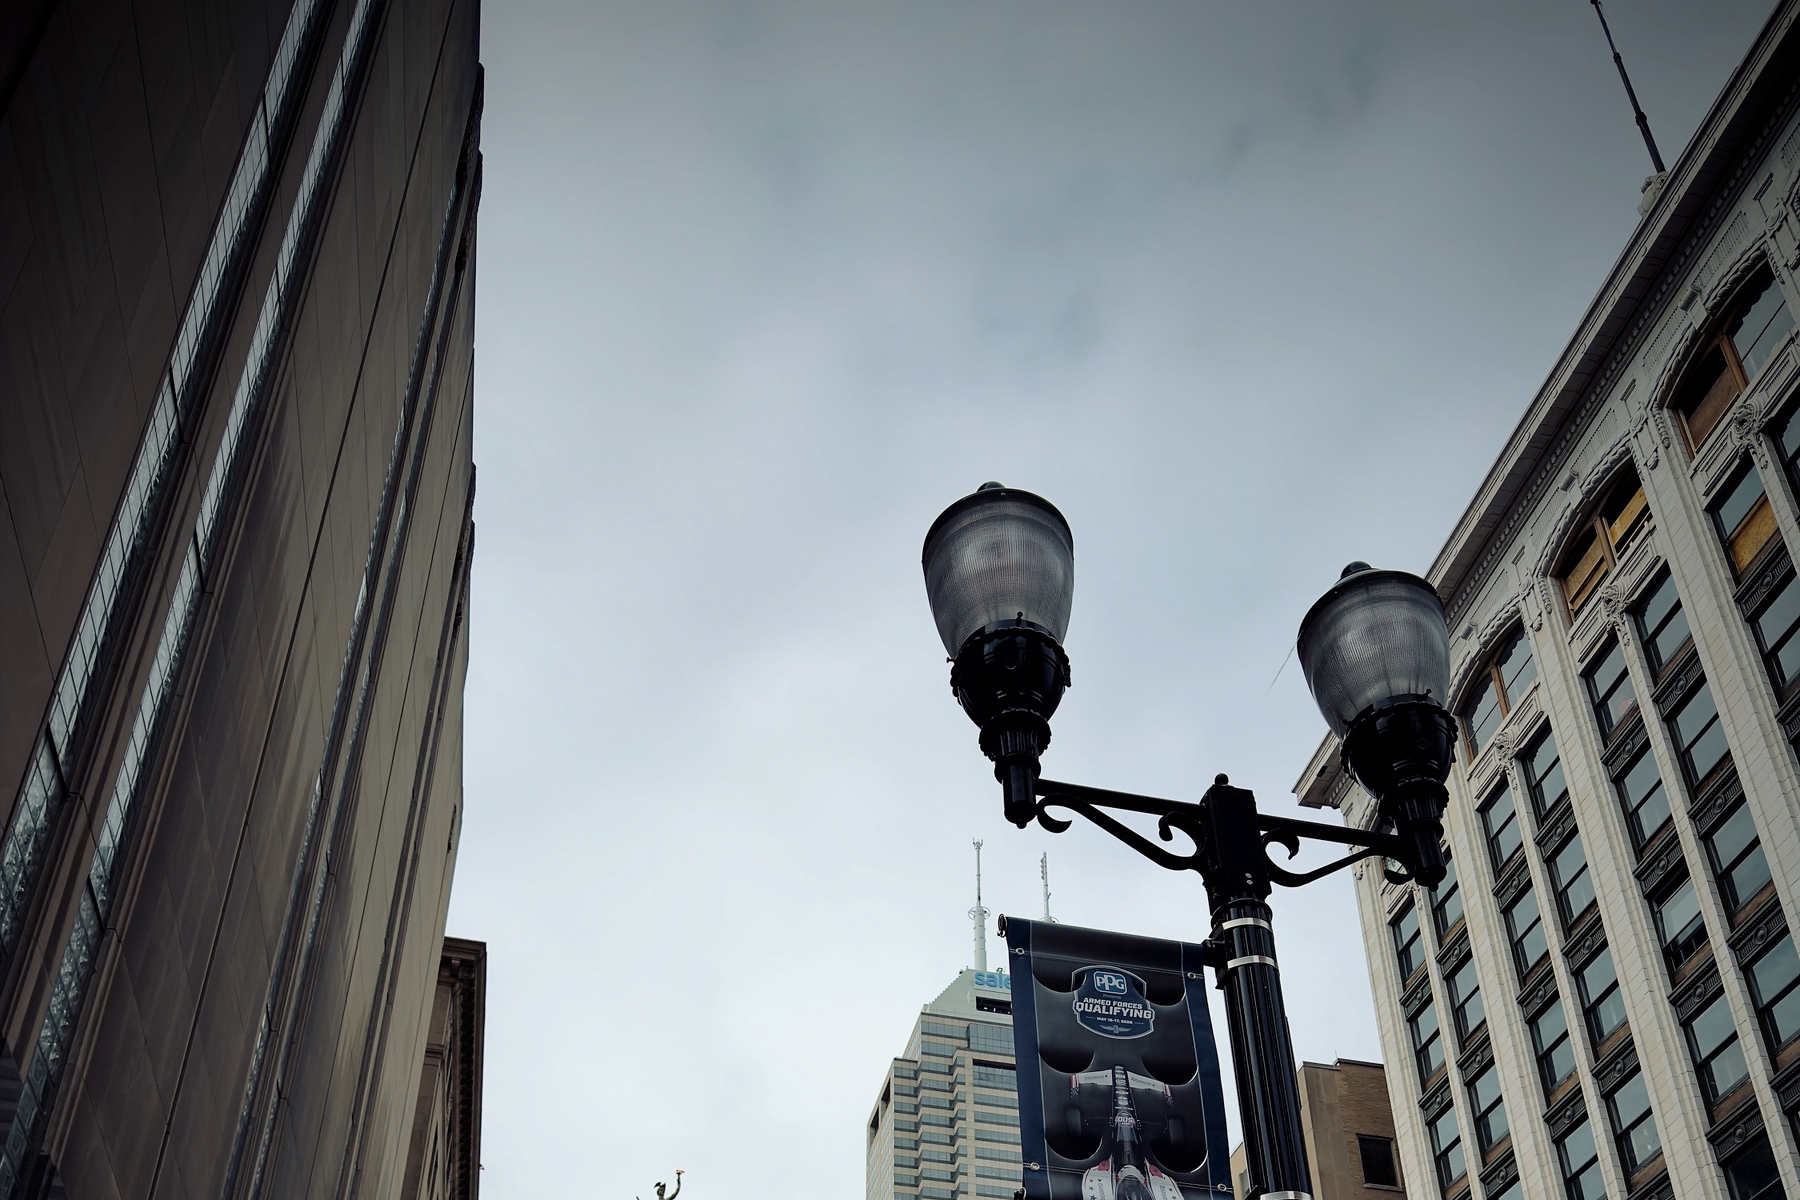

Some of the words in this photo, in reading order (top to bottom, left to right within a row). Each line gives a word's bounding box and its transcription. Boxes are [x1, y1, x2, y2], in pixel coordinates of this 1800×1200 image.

[1096, 974, 1125, 990] PPG
[1075, 1001, 1152, 1019] QUALIFYING
[1083, 997, 1111, 1006] ARMED
[1112, 1001, 1143, 1010] FORCES
